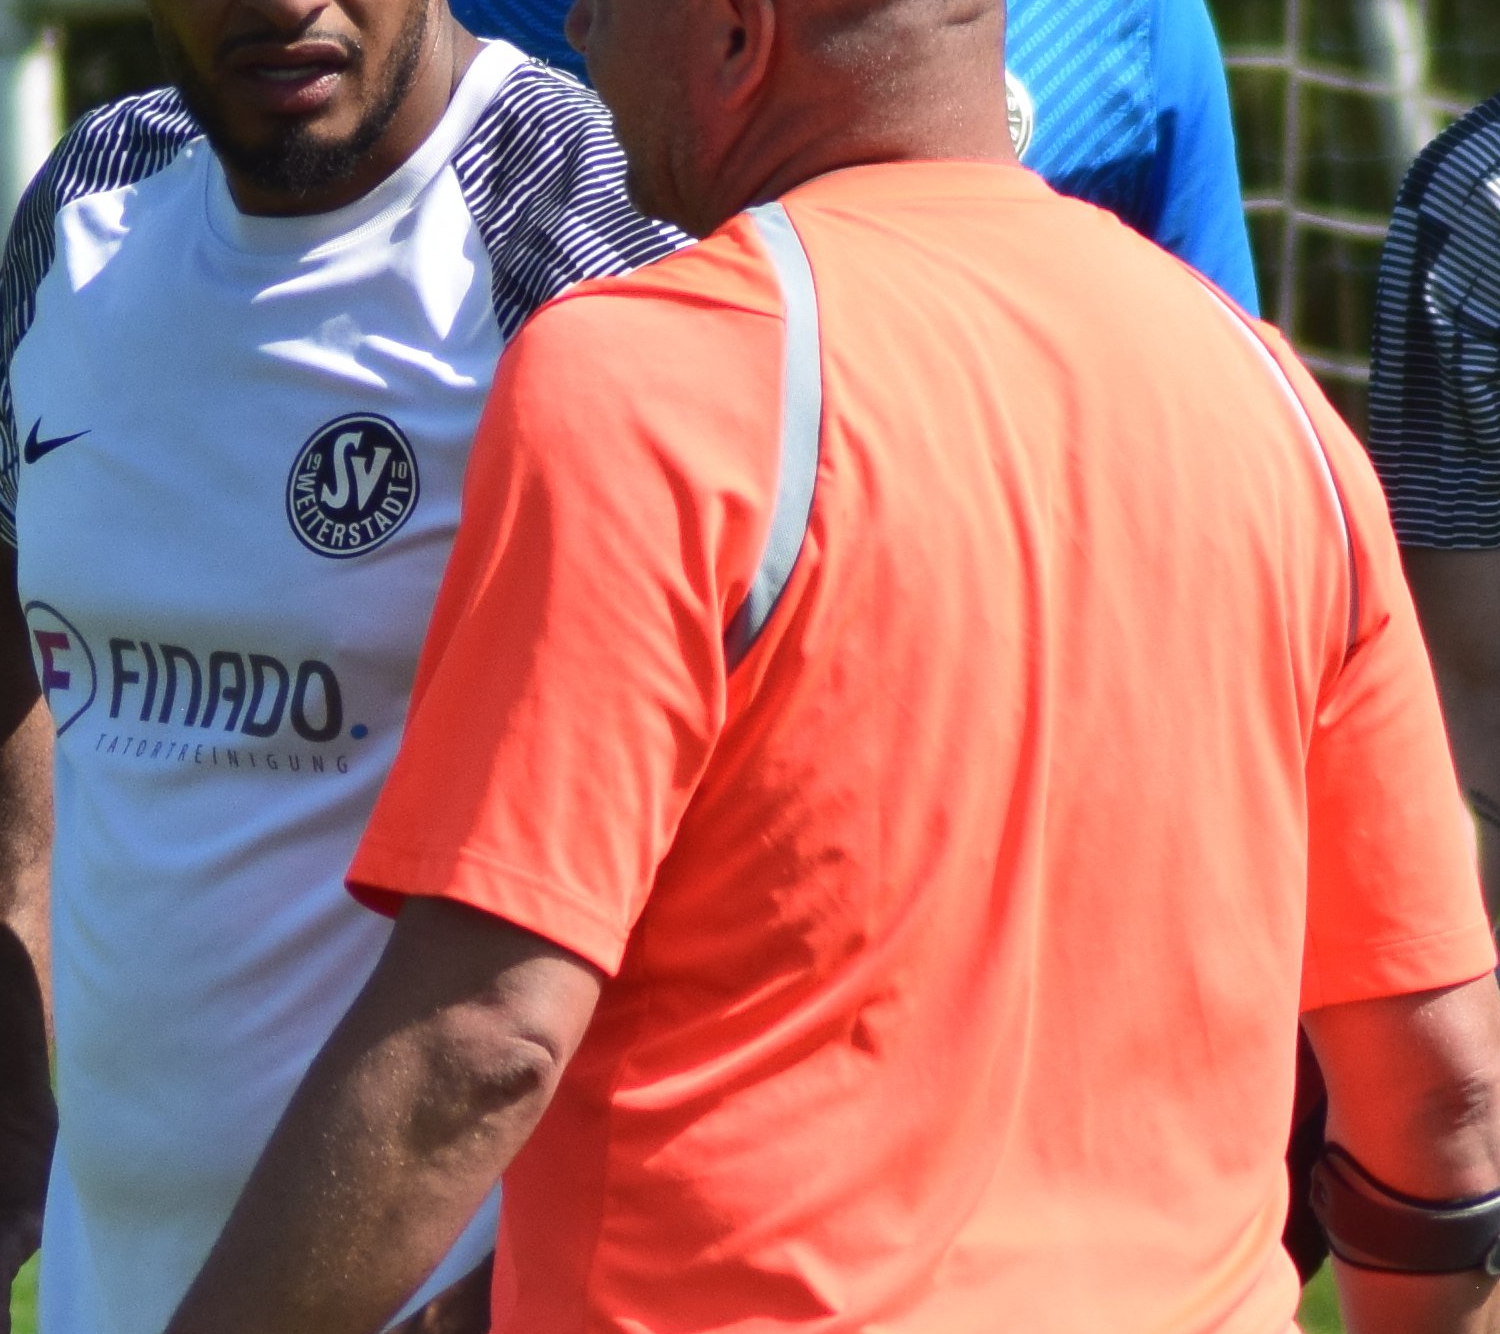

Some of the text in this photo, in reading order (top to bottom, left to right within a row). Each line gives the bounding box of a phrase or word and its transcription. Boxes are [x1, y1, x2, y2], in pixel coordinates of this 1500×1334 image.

[306, 452, 322, 471] 19
[320, 431, 392, 512] SV
[296, 471, 410, 548] WEITERSTADT
[94, 732, 350, 775] TATORTREINIGUNG
